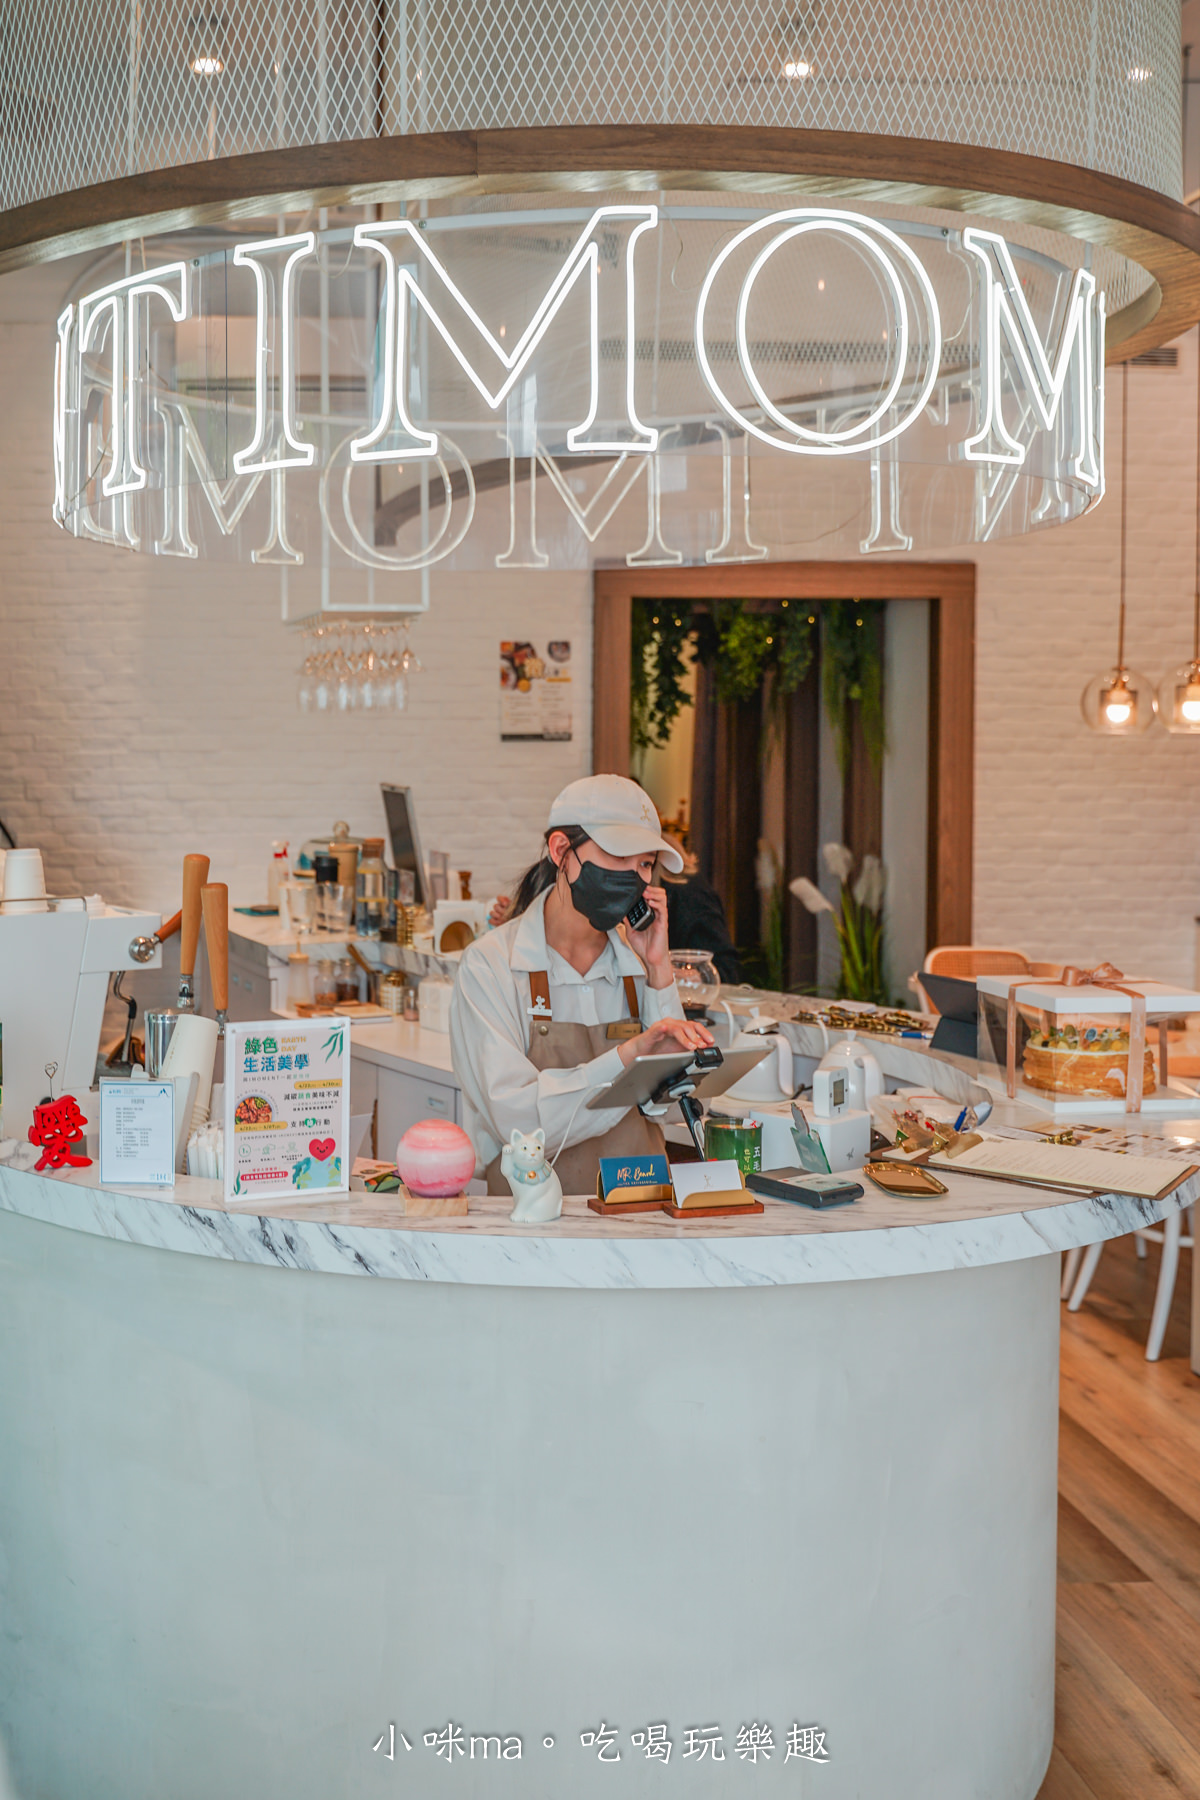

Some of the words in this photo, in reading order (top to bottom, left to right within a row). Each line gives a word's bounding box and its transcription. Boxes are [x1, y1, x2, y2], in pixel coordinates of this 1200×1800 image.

[244, 1036, 278, 1055] 綠色
[281, 1036, 306, 1044] EARTH
[243, 1053, 310, 1073] 生活美學
[752, 1145, 761, 1172] 五毛
